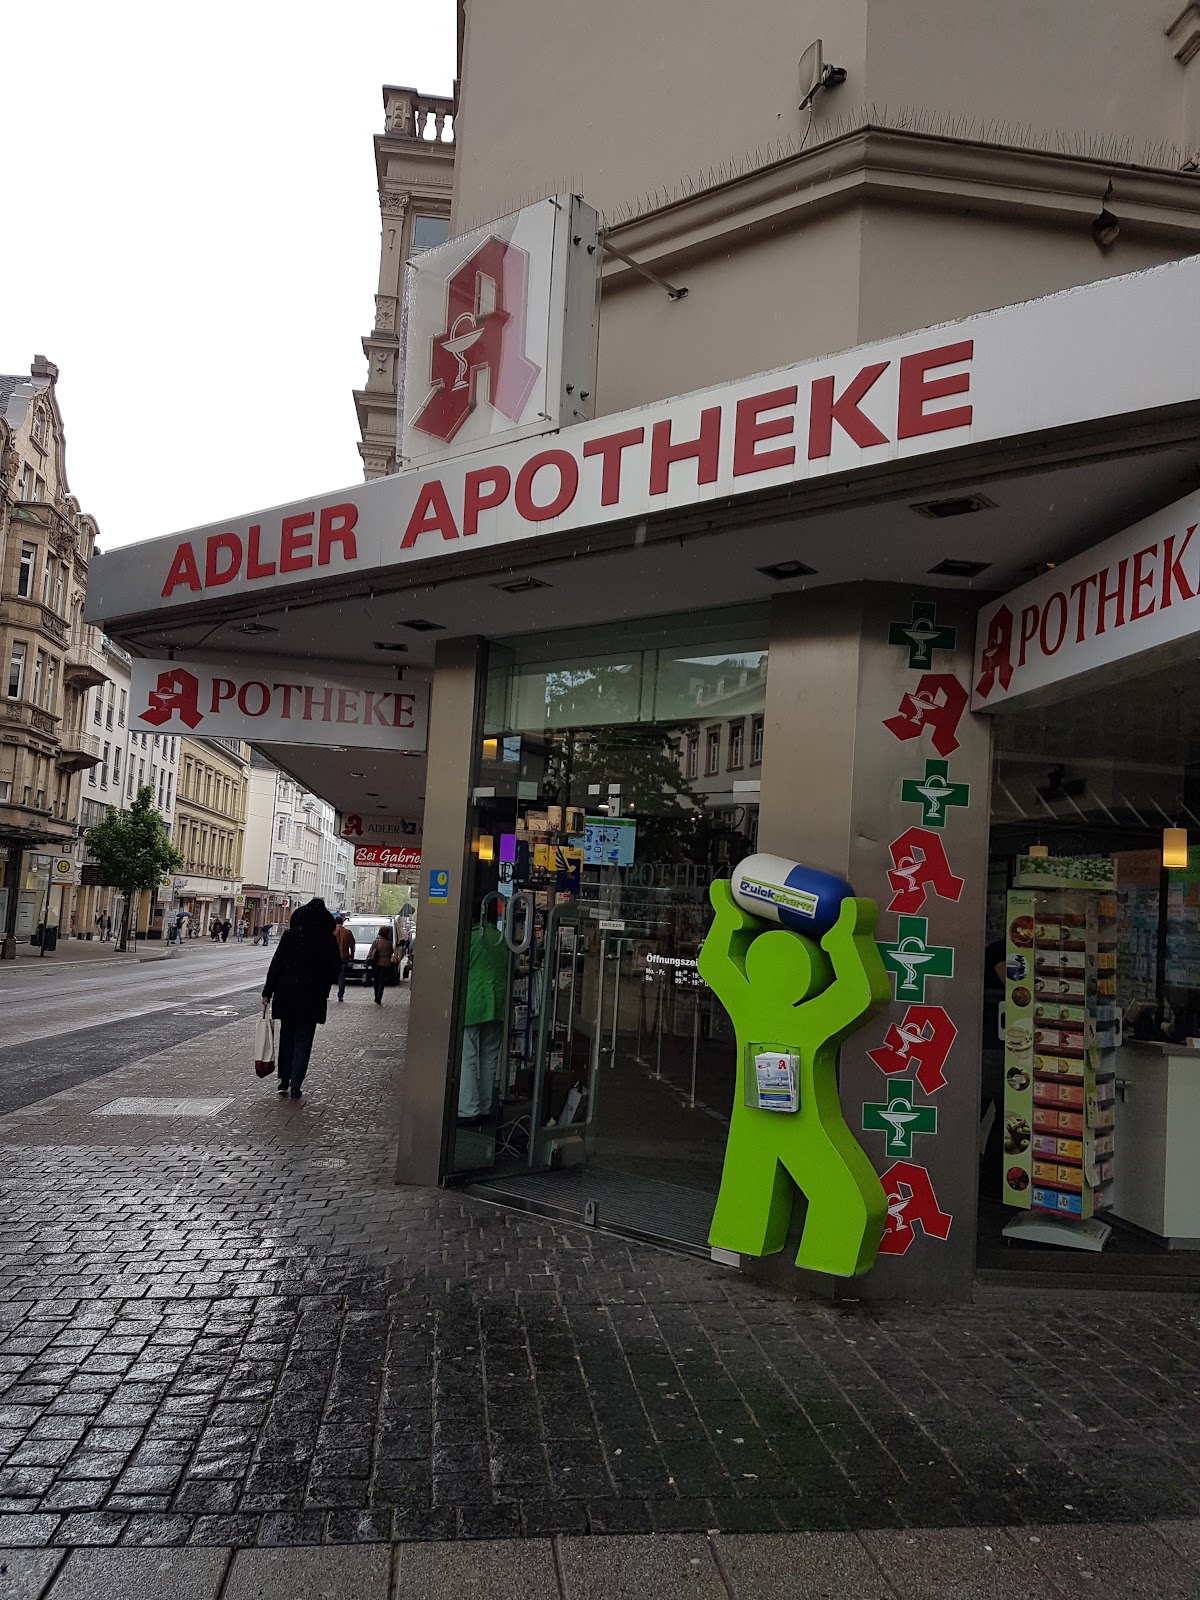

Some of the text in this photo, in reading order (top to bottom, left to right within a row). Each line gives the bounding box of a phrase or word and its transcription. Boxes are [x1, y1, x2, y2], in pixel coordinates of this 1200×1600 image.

[161, 339, 974, 598] ADLER APOTHEKE
[975, 523, 1200, 699] APOTHEK
[368, 823, 400, 835] ADLER
[356, 847, 421, 864] Bei Gabrie
[740, 881, 815, 912] Quickpharm
[646, 953, 698, 967] Öffnungszei
